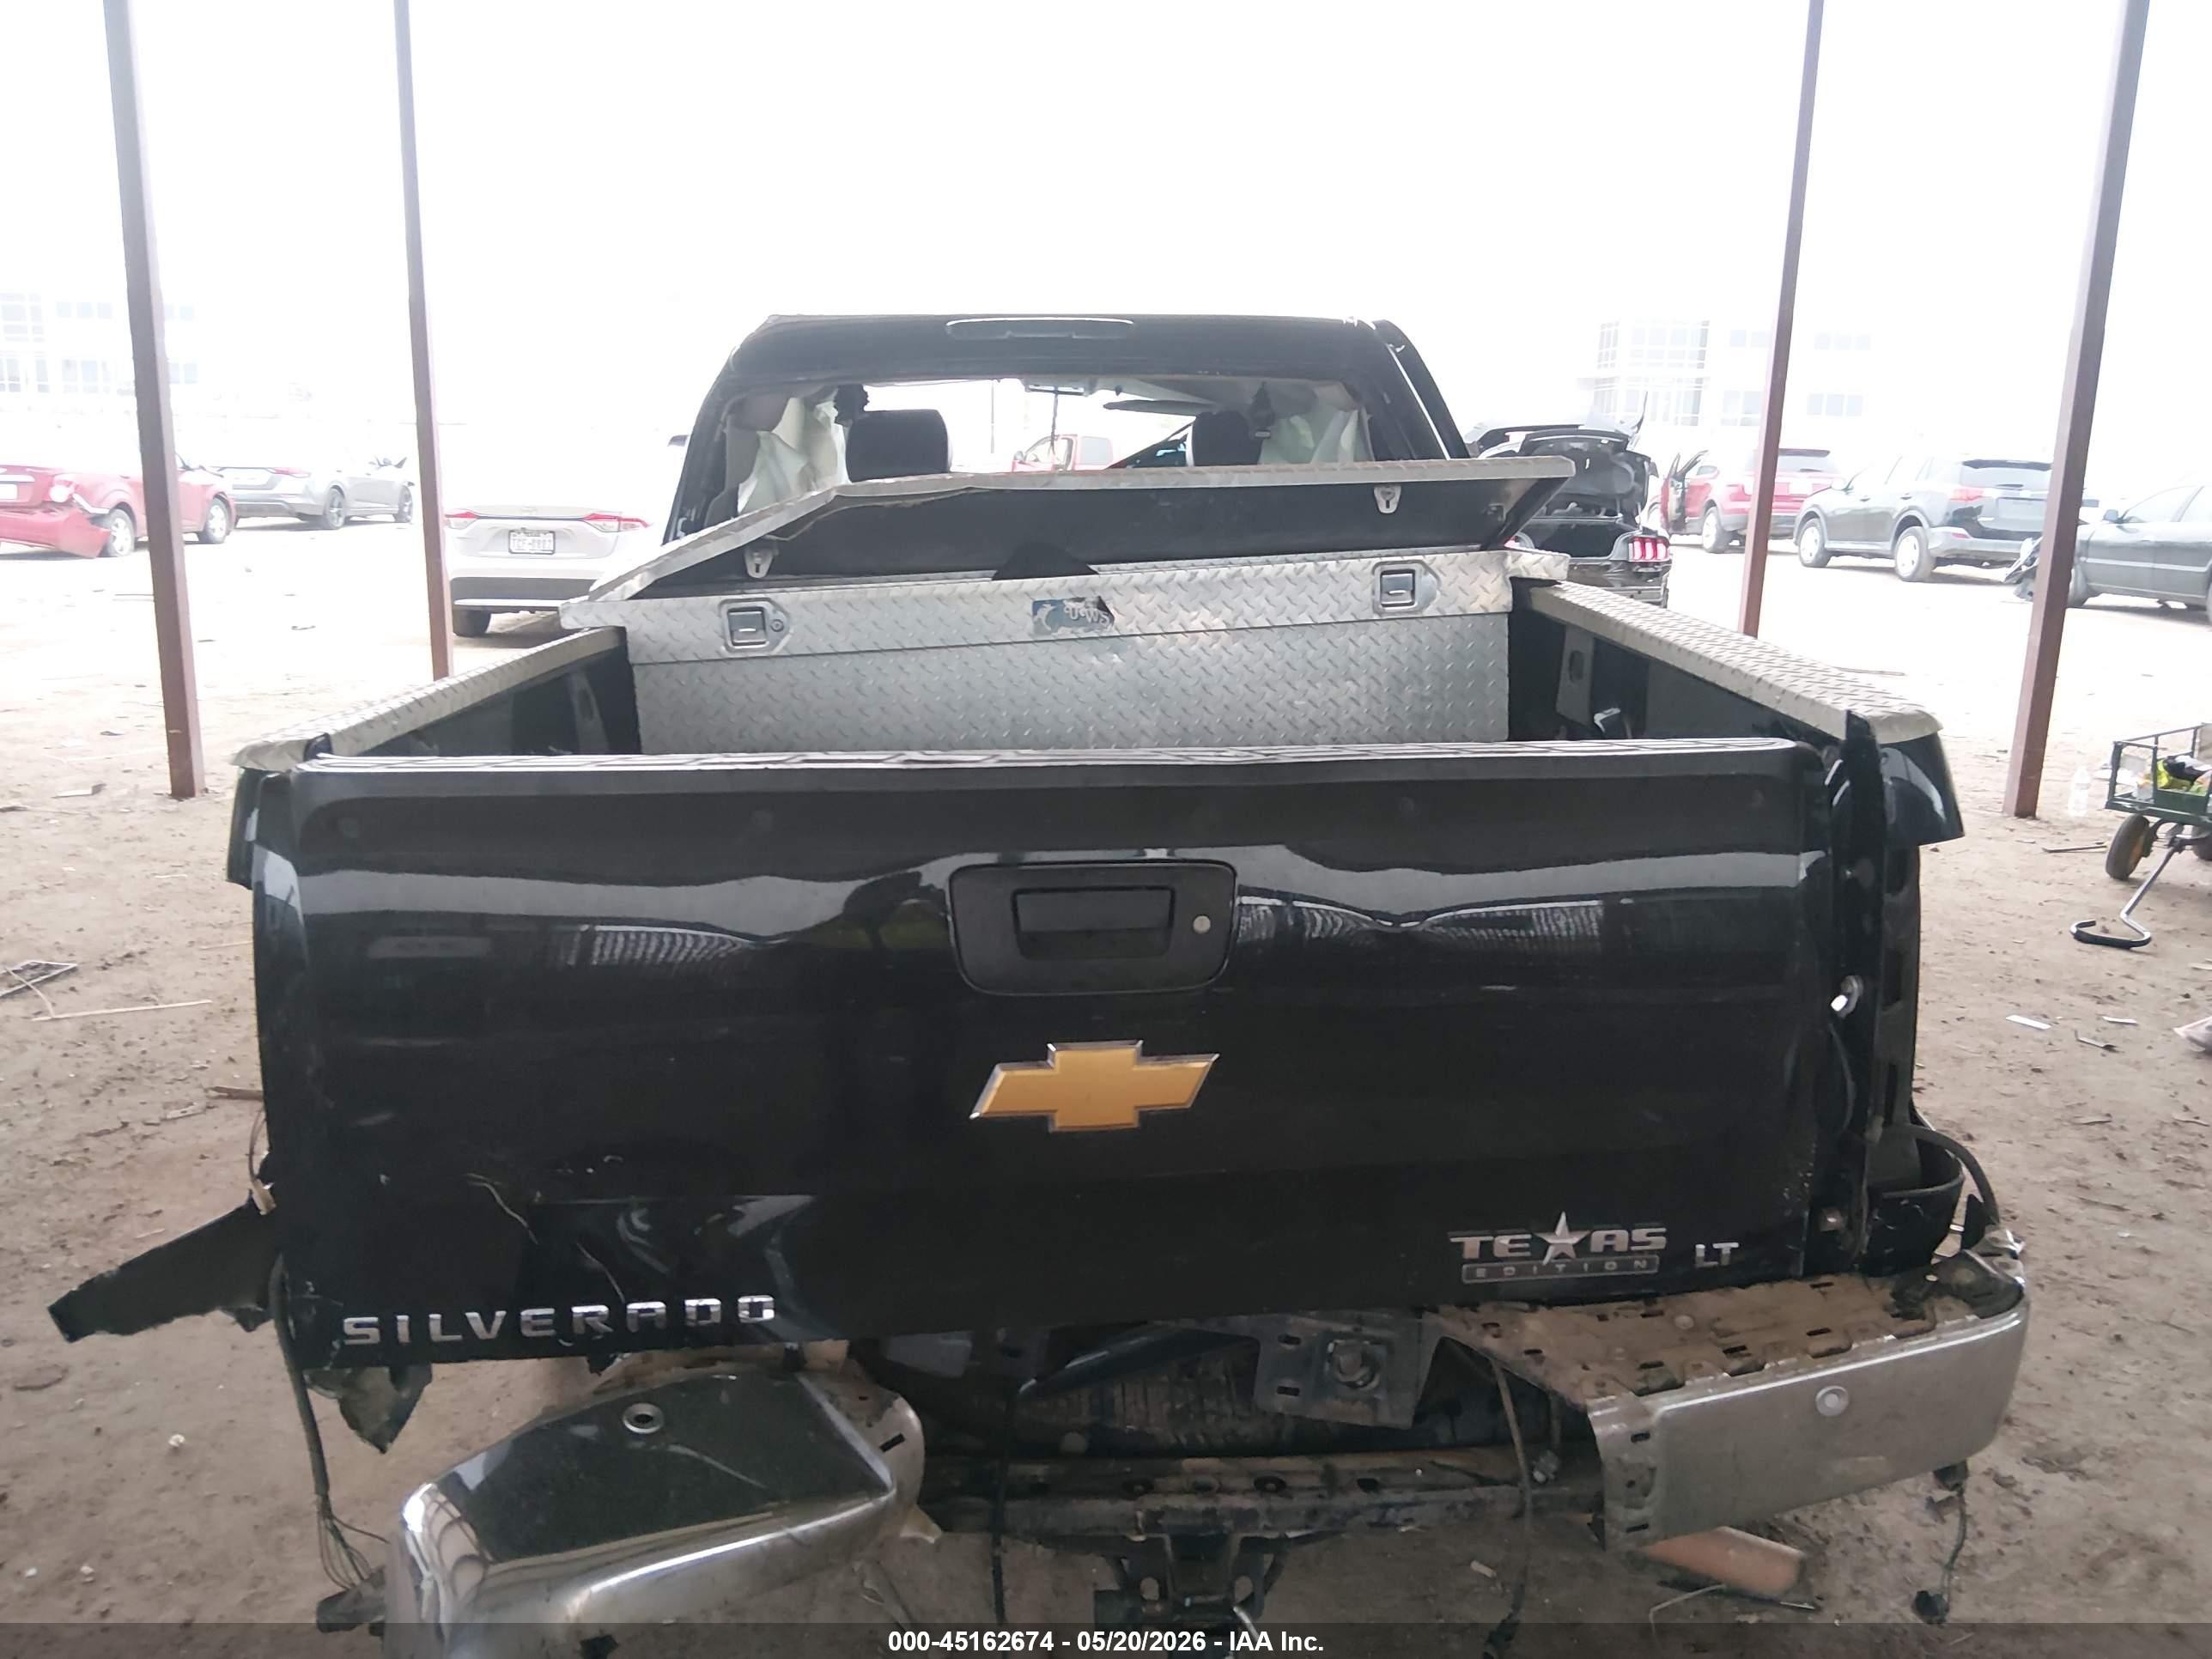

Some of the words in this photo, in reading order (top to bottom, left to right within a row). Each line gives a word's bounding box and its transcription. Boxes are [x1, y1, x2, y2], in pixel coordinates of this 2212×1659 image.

[1063, 606, 1109, 627] UWS
[1695, 1242, 1740, 1267] LT
[1474, 1259, 1650, 1279] EDITION
[343, 1294, 775, 1346] SILVERADO
